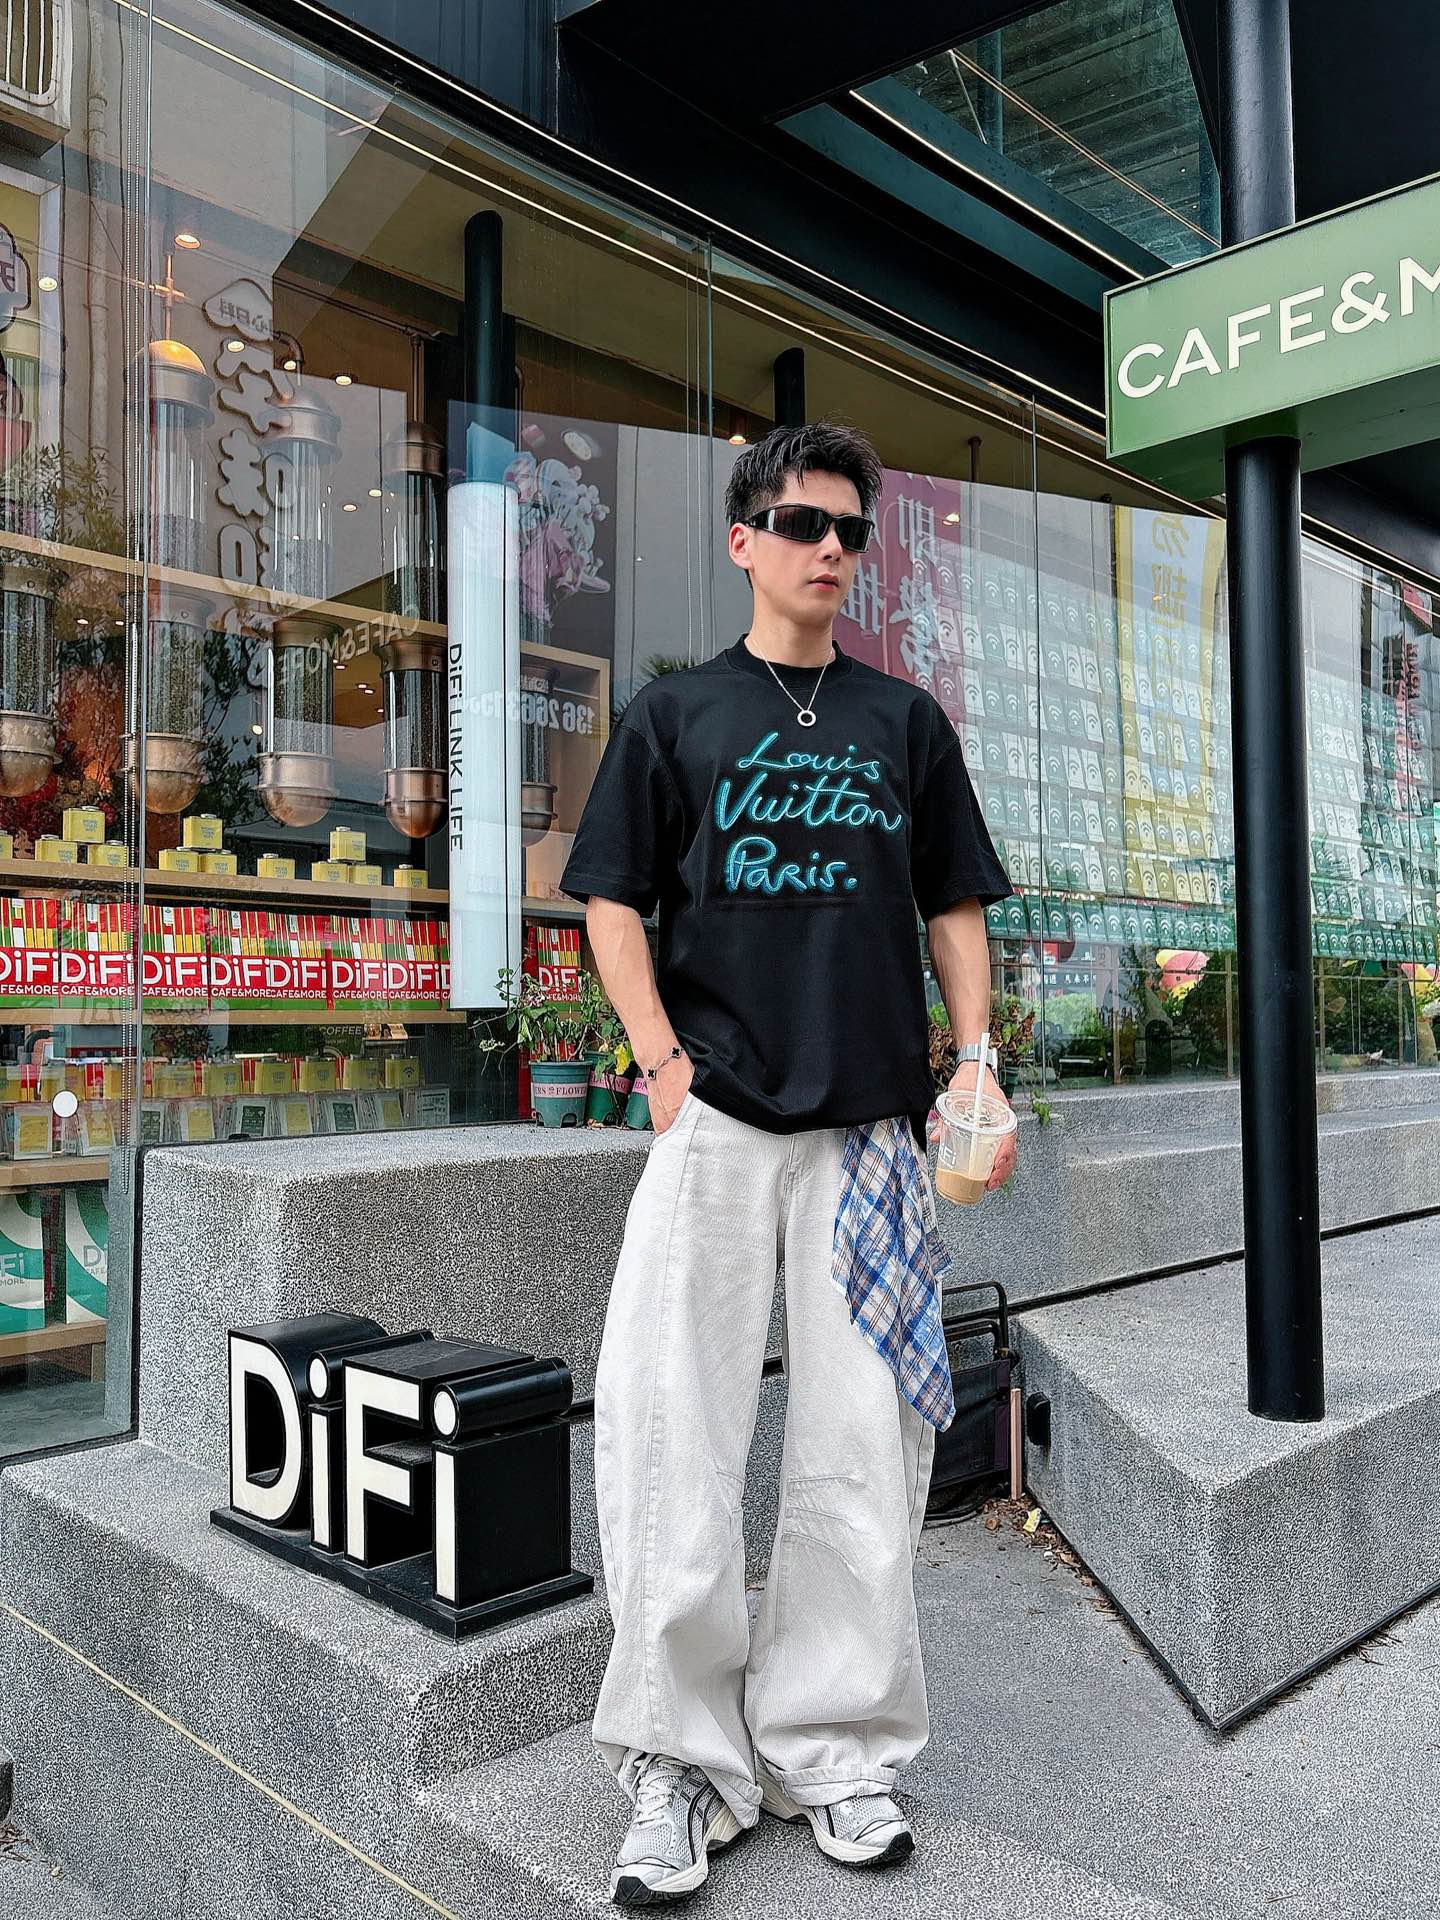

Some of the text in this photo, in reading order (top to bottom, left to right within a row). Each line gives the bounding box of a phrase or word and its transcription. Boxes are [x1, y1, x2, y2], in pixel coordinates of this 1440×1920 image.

[1117, 256, 1440, 399] CAFE&M
[449, 643, 463, 852] DiFi LINK LIFE
[737, 732, 880, 780] Louis
[716, 772, 902, 831] Vuitton
[61, 952, 135, 985] DiFi
[142, 956, 207, 986] DiFi
[211, 957, 271, 987] DiFi
[270, 959, 327, 988] DiFi
[332, 960, 388, 989] DiFi
[388, 961, 440, 990] DiFi
[61, 986, 135, 996] CAFE&MORE
[142, 986, 208, 997] CAFE&MORE
[211, 988, 271, 998] CAFE&MORE
[271, 989, 327, 999] CAFE&MORE
[333, 990, 387, 999] CAFE&MORE
[389, 991, 440, 1000] CAFE&MORE
[319, 1026, 362, 1036] COFFEE
[0, 1252, 25, 1277] Fi
[229, 1336, 457, 1603] DiFi
